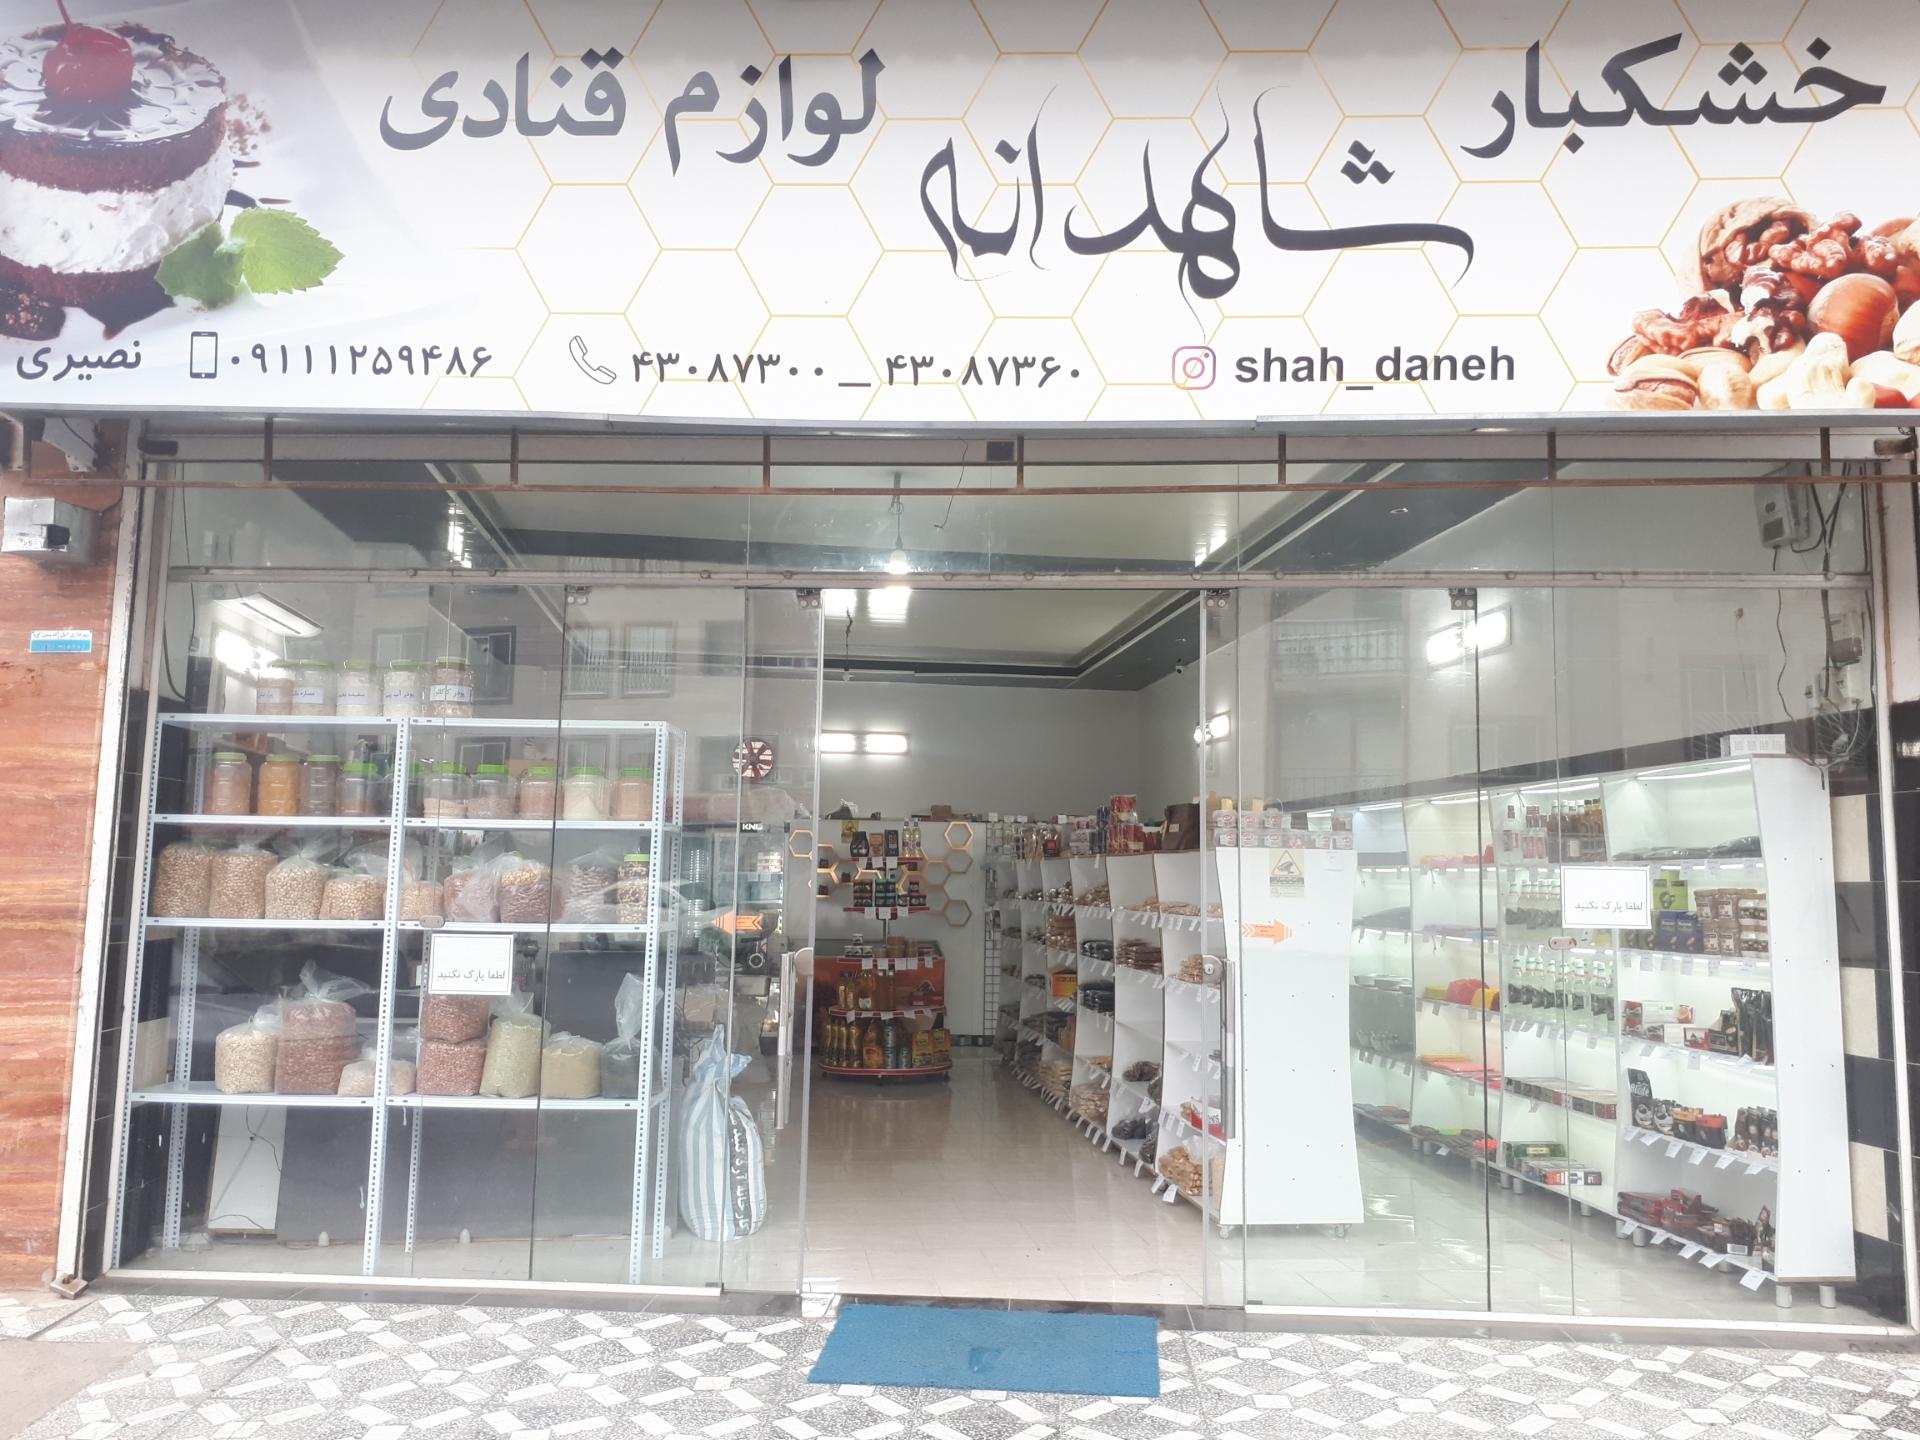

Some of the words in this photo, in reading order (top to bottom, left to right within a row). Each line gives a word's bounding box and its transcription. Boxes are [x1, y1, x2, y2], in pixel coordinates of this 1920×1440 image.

[380, 47, 626, 150] قنادی
[663, 49, 885, 175] لوازم
[1460, 33, 1887, 158] خشکبار
[16, 338, 141, 381] نصیری
[230, 343, 493, 378] ۰۹۱۱۱۲۵۹۴۸۶
[1235, 346, 1515, 391] shah_daneh
